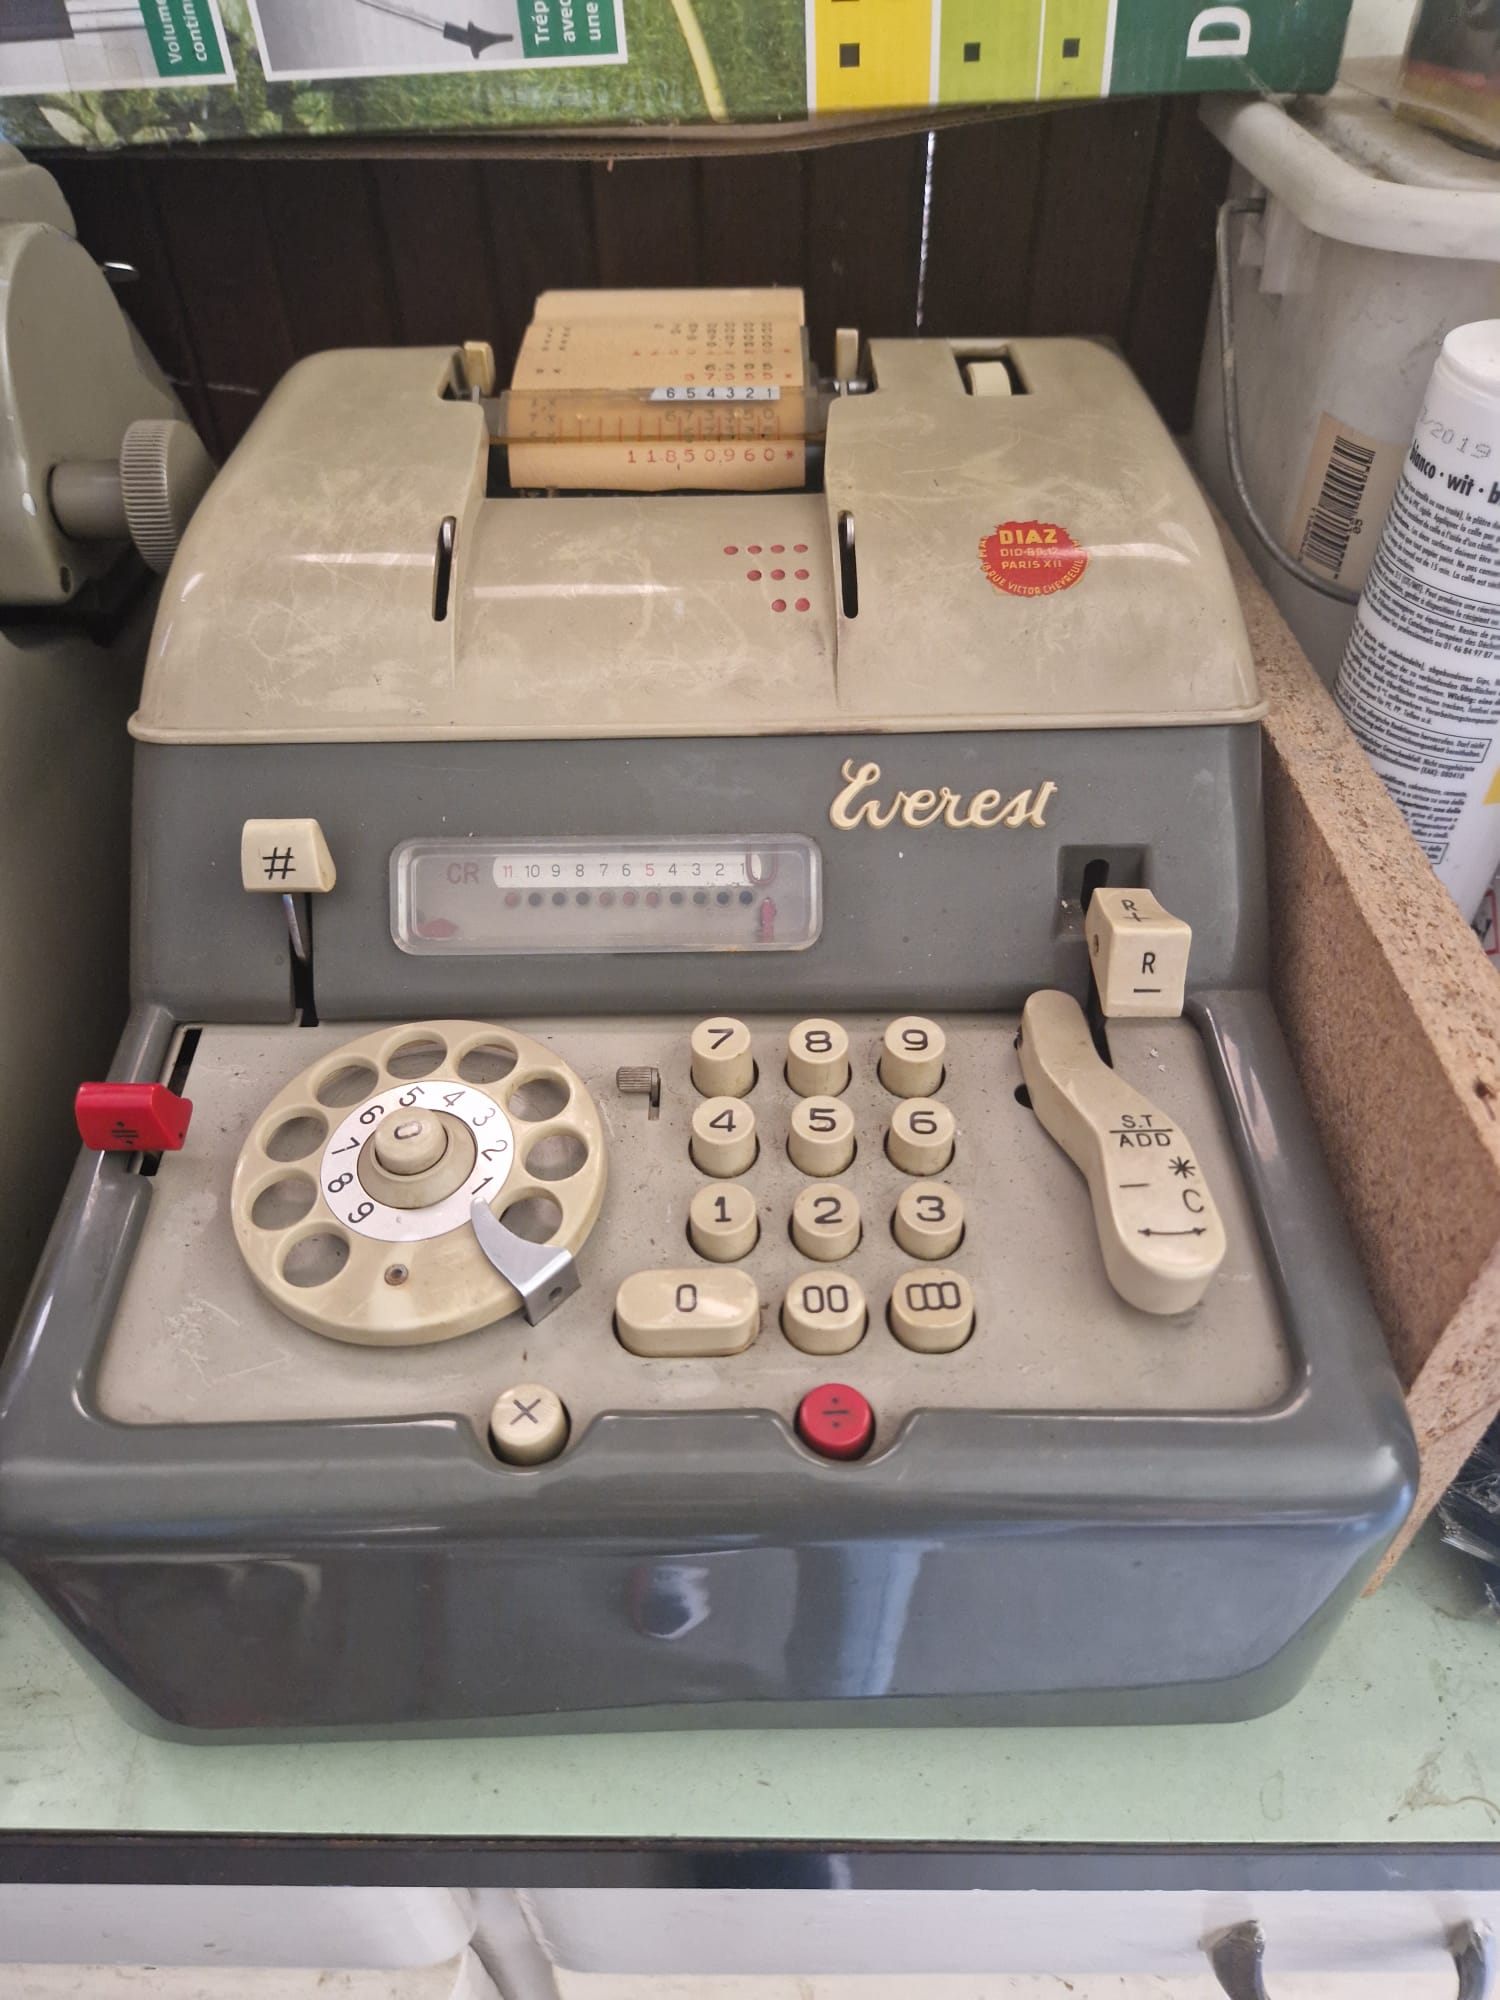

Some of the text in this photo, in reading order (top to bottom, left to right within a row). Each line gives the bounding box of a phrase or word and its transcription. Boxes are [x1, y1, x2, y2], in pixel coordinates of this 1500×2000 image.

[182, 0, 207, 61] contin
[586, 2, 601, 41] une
[1186, 6, 1251, 58] D
[666, 388, 773, 400] 6 5 4 3 2 1
[1409, 439, 1436, 479] bianco
[1446, 473, 1475, 497] wit
[1487, 481, 1500, 504] b
[999, 528, 1058, 545] DIAZ
[1001, 560, 1062, 570] PARIS XII
[988, 568, 1007, 586] RUE
[1008, 582, 1041, 595] VICTOR
[1042, 559, 1084, 594] CHEVREUIL
[829, 758, 1059, 831] Everest
[446, 862, 480, 885] CR
[503, 863, 513, 878] 11
[525, 863, 541, 878] 10
[551, 863, 561, 878] 9
[575, 863, 585, 878] 8
[600, 863, 609, 878] 7
[622, 863, 631, 878] 6
[645, 863, 655, 878] 5
[668, 863, 678, 878] 4
[691, 863, 701, 878] 3
[715, 863, 725, 878] 2
[1121, 899, 1137, 912] R
[1141, 951, 1156, 975] R
[706, 1028, 929, 1053] 7 8 9
[399, 1085, 426, 1108] 5
[443, 1089, 467, 1108] 4
[359, 1104, 385, 1125] 6
[472, 1106, 496, 1127] 3
[708, 1108, 938, 1135] 4 5 6
[331, 1136, 360, 1157] 7
[480, 1139, 509, 1162] 2
[1118, 1131, 1172, 1148] ADD
[327, 1172, 354, 1194] 8
[471, 1176, 494, 1196] 1
[347, 1201, 375, 1225] 9
[713, 1195, 946, 1224] 1 2 3
[1182, 1190, 1205, 1214] C
[675, 1281, 962, 1314] 0 00 000
